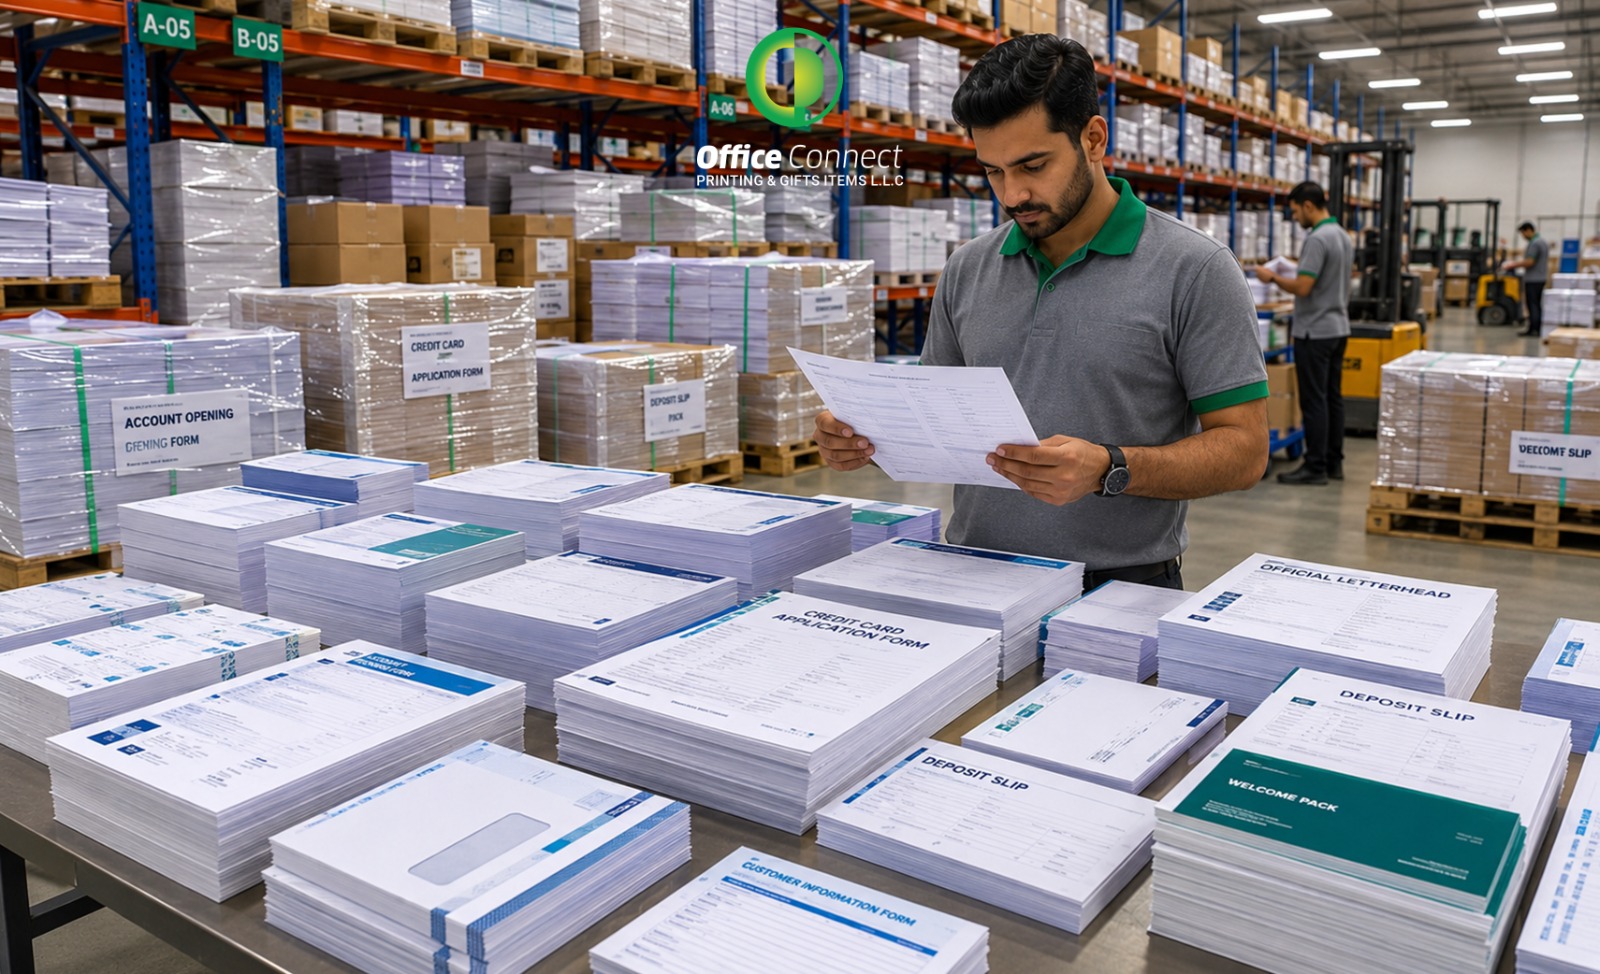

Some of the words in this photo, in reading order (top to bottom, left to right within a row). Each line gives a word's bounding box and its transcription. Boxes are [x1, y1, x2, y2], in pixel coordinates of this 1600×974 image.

[143, 13, 191, 39] A-05
[237, 27, 279, 52] B-05
[710, 100, 734, 116] A-06
[411, 340, 441, 352] CREDIT
[442, 339, 465, 350] CARD
[411, 368, 461, 382] APPLICATION
[462, 366, 484, 377] FORM
[124, 412, 183, 429] ACCOUNT
[185, 408, 234, 423] OPENING
[170, 434, 200, 447] FORM
[1568, 447, 1592, 459] SLIP
[1260, 563, 1332, 582] OFFICIAL
[1336, 576, 1452, 599] LETTERHEAD
[771, 613, 880, 640] APPLICATION
[879, 634, 930, 650] FORM
[803, 610, 861, 625] CREDIT
[859, 621, 905, 636] CARD
[1339, 689, 1427, 713] DEPOSIT
[1430, 707, 1475, 722] SLIP
[921, 756, 992, 781] DEPOSIT
[990, 775, 1030, 791] SLIP
[1228, 777, 1298, 802] WELCOME
[1298, 796, 1340, 813] PACK
[741, 860, 802, 887] CUSTOMER
[800, 881, 880, 914] INFORMATION
[879, 908, 917, 927] FORM
